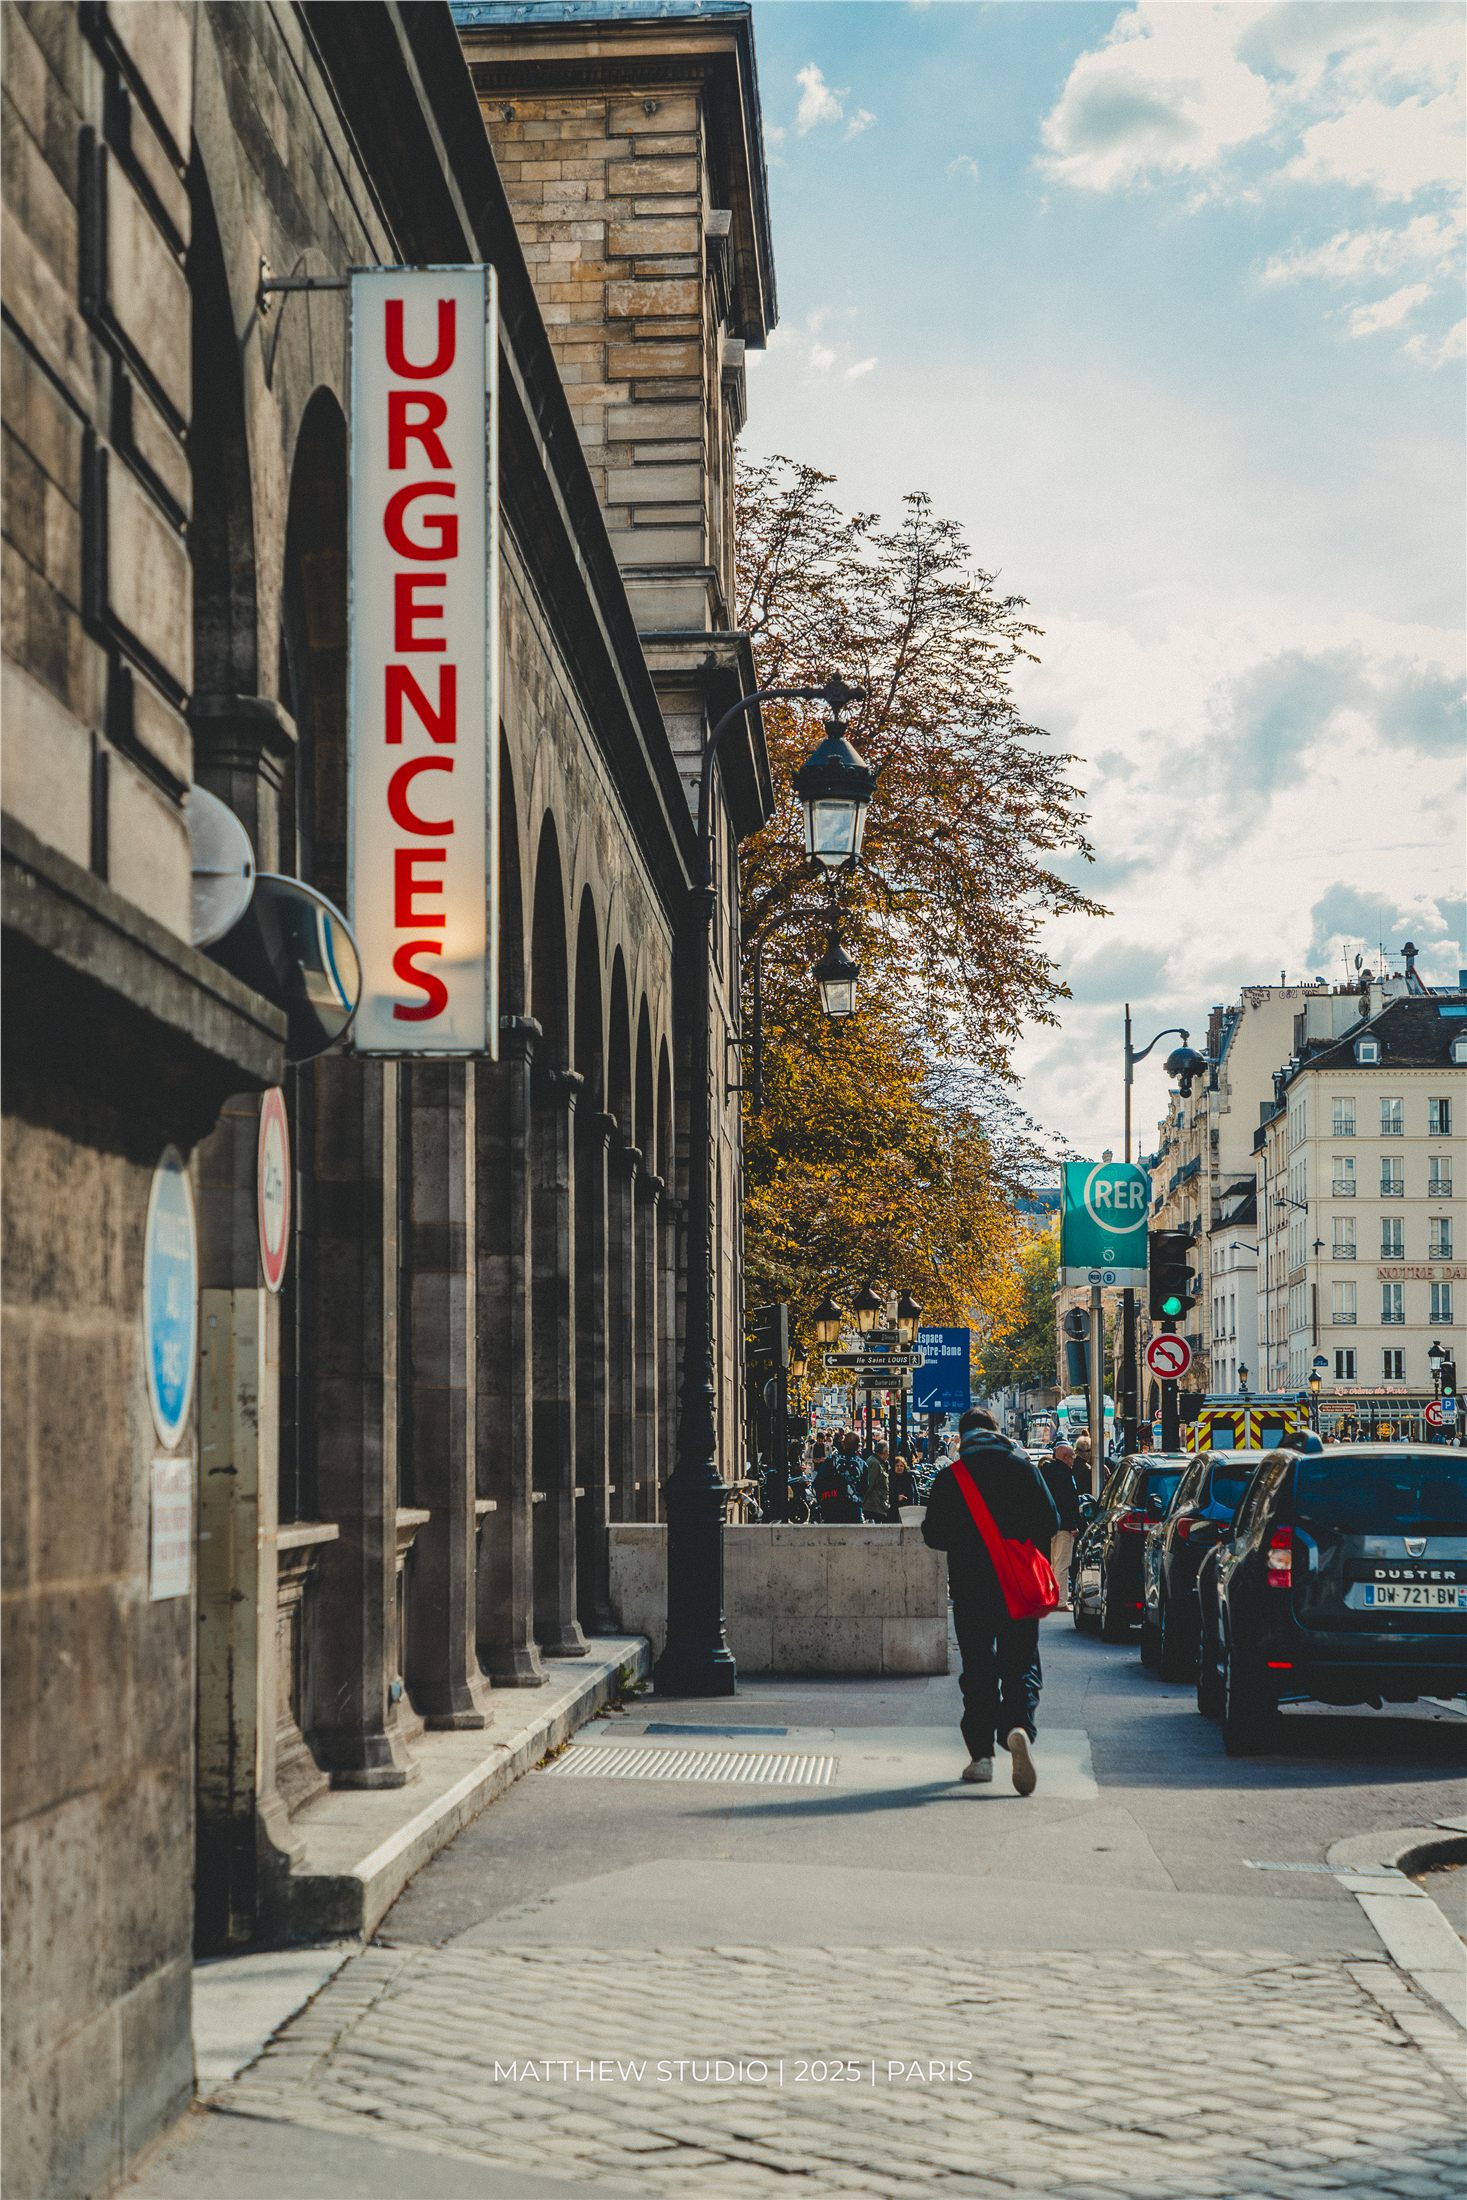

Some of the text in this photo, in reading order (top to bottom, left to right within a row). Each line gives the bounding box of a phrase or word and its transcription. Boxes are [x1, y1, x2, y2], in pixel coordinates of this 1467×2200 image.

[383, 298, 459, 1022] URGENCES
[1094, 1180, 1145, 1210] RER
[1376, 1266, 1435, 1280] NOTRE
[917, 1332, 943, 1345] Espace
[917, 1345, 962, 1356] Notre-Dame
[867, 1356, 886, 1364] Saint
[887, 1356, 908, 1364] LOUIS
[1374, 1569, 1457, 1580] DUSTER
